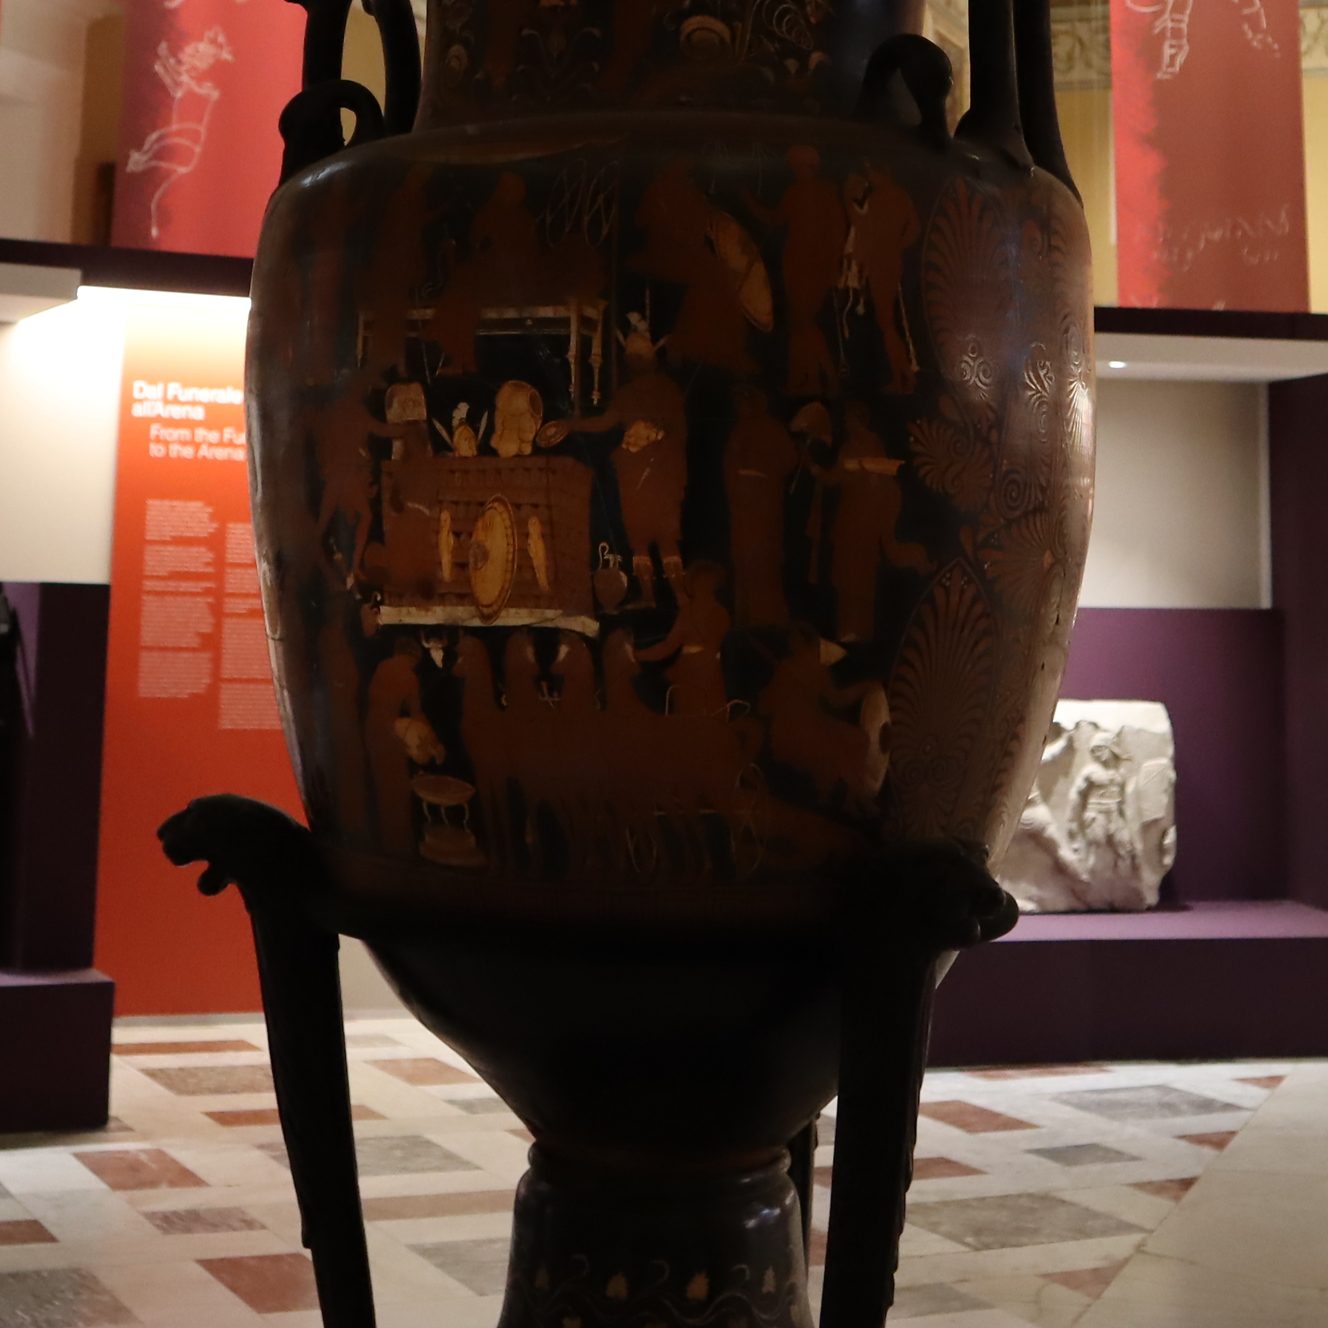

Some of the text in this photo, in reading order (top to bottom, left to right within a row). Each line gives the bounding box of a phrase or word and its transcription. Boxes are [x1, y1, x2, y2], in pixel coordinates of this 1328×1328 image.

[133, 380, 243, 404] Dal Funerale
[149, 423, 192, 441] From
[194, 427, 221, 444] the
[149, 442, 245, 461] to the Arena
